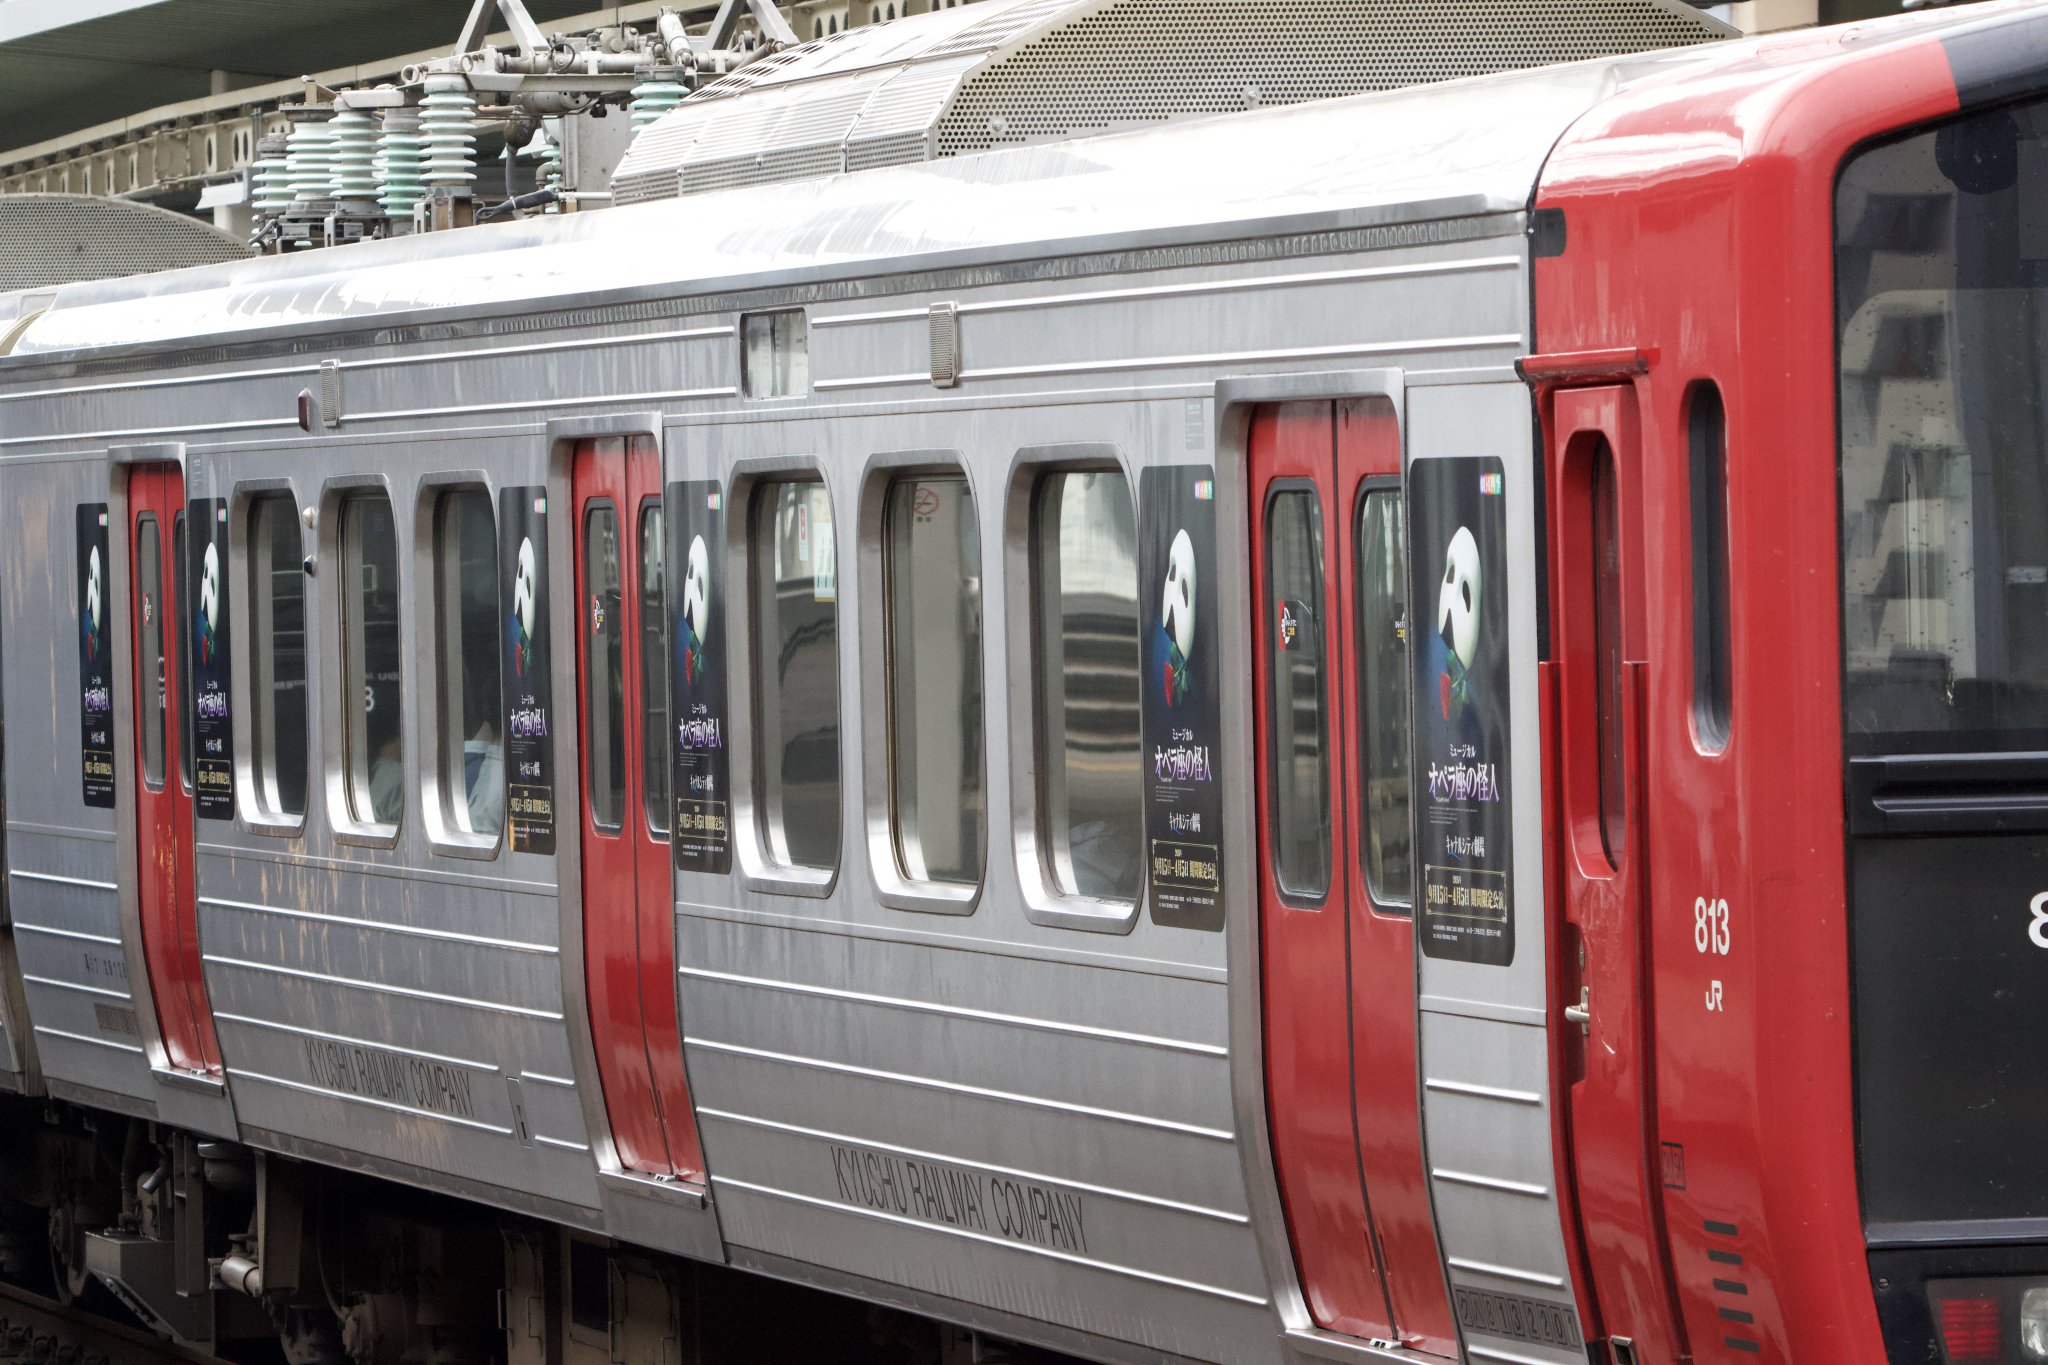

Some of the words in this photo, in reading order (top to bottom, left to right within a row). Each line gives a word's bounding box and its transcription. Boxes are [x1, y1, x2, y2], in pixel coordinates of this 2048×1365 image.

[1154, 744, 1213, 783] オペラ座の怪人
[1449, 743, 1477, 759] ミュージカル
[1428, 761, 1500, 803] オペラ座の怪人
[1694, 896, 1730, 955] 813
[1705, 979, 1723, 1011] JR
[304, 1039, 358, 1093] KYUSHU
[354, 1049, 410, 1103] RAILWAY
[409, 1059, 475, 1118] COMPANY
[830, 1145, 908, 1215] KYUSHU
[906, 1161, 988, 1231] RAILWAY
[990, 1177, 1088, 1254] COMPANY
